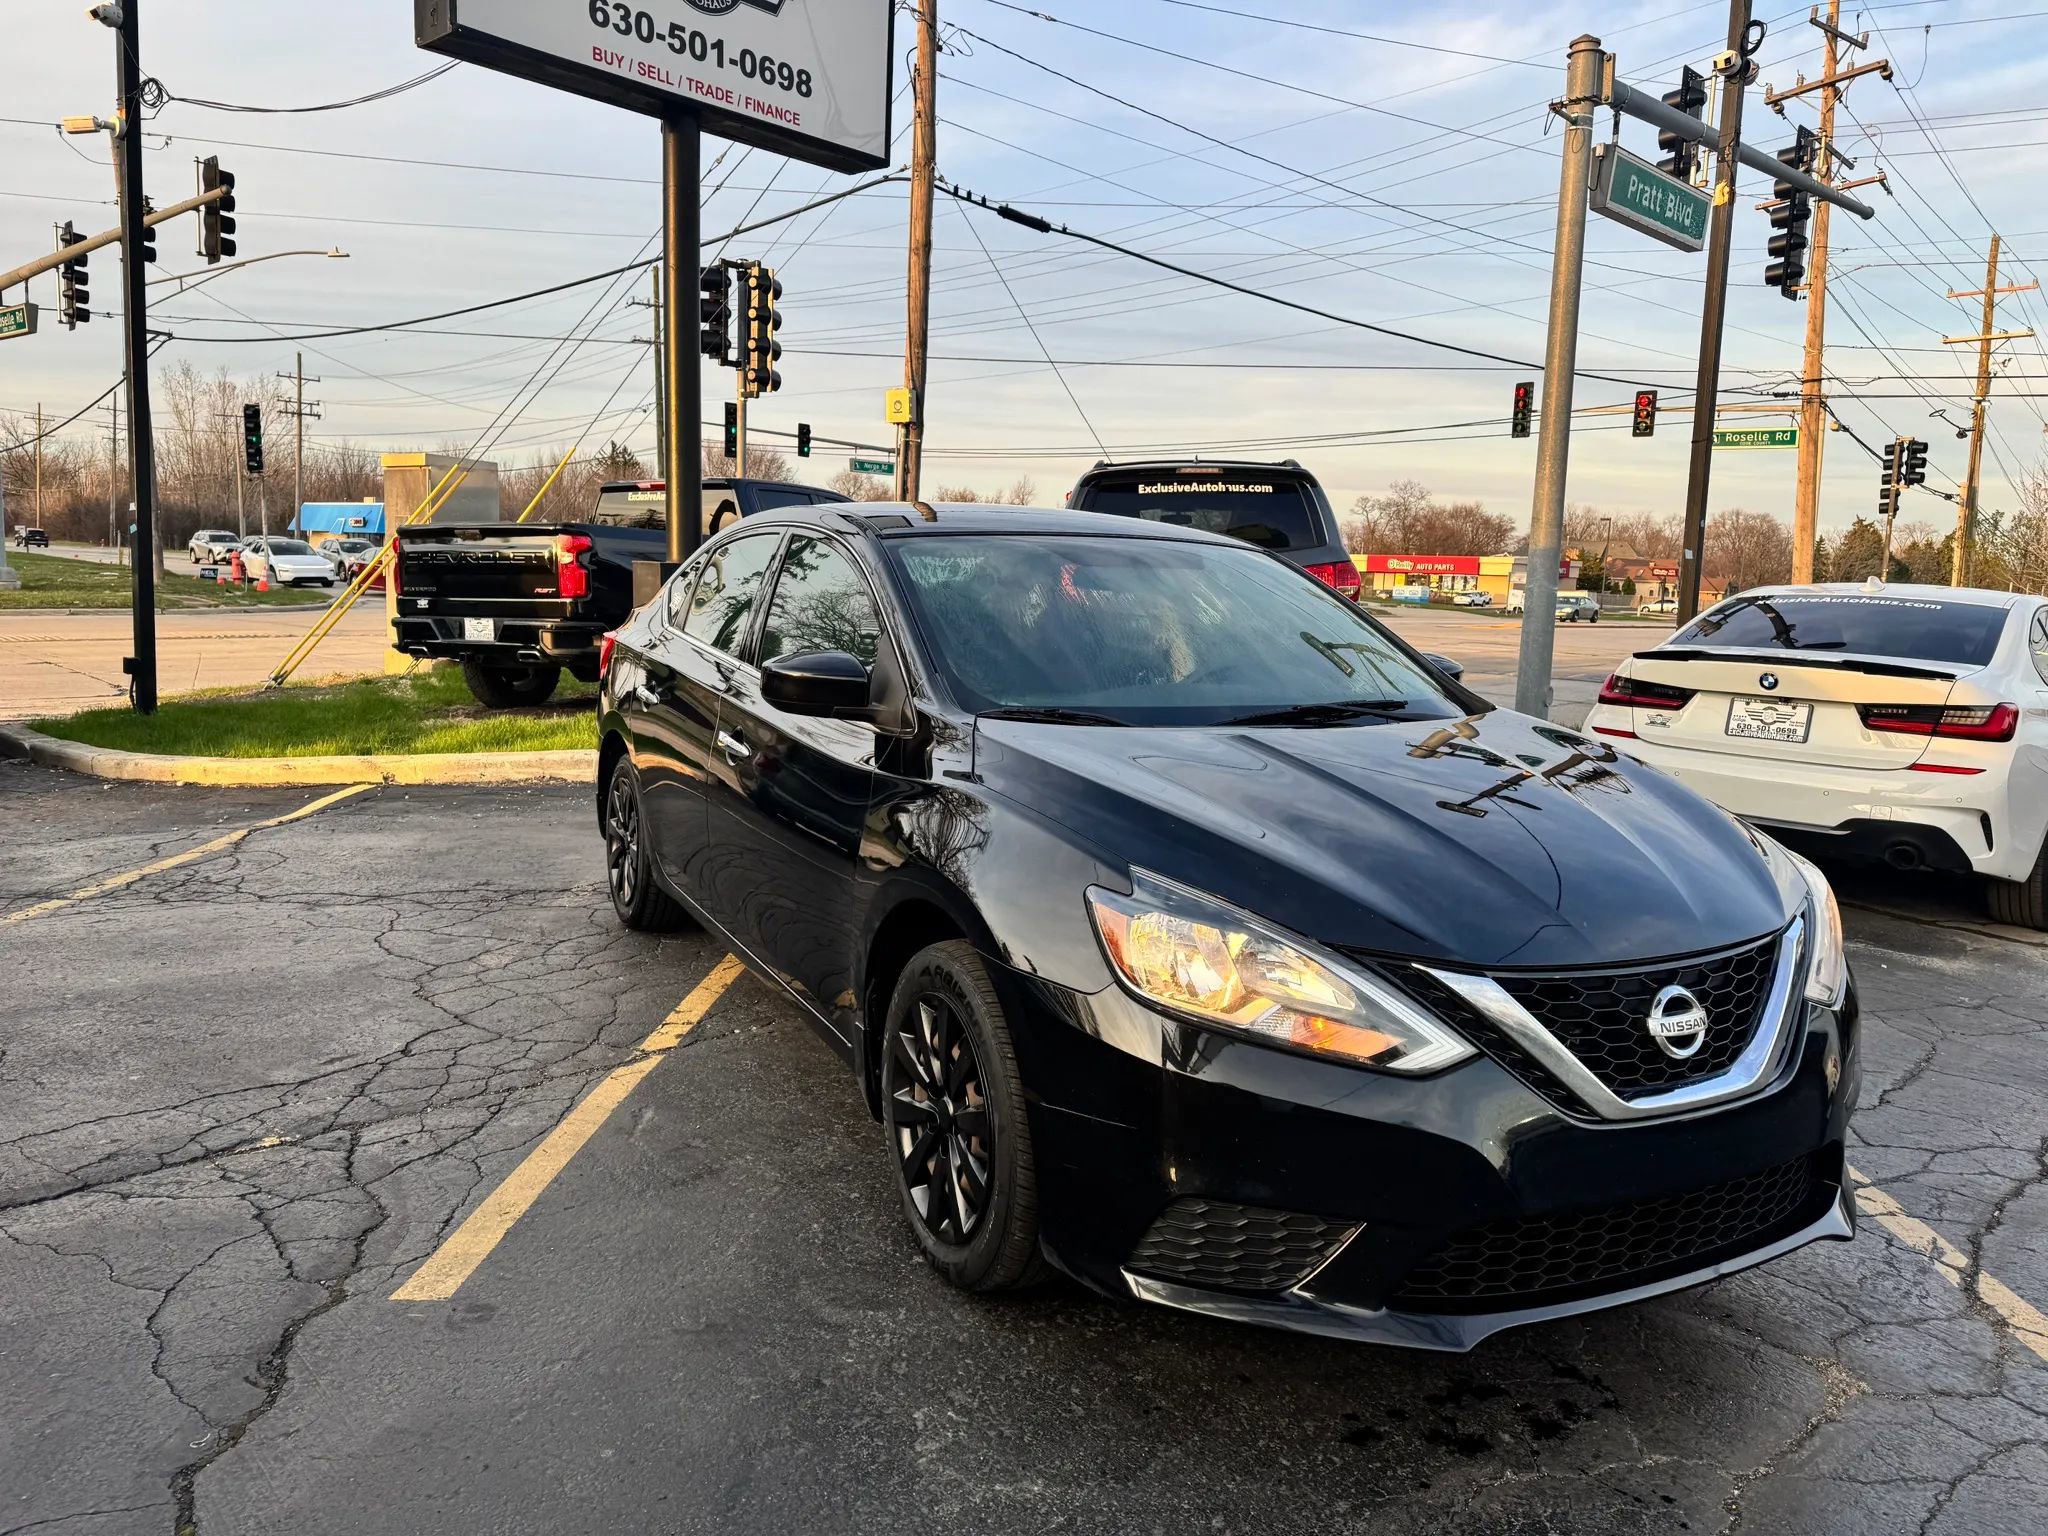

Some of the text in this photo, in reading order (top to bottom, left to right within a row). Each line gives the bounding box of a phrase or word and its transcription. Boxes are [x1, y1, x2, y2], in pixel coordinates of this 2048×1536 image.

[588, 0, 813, 98] 630-501-0698
[592, 46, 625, 69] BUY
[637, 61, 674, 86] SELL
[686, 77, 734, 105] TRADE
[745, 96, 801, 126] FINANCE
[1627, 174, 1694, 227] Pratt Blvd
[1725, 431, 1791, 442] Roselle Rd
[406, 552, 544, 564] CHEVROLET
[1416, 563, 1433, 571] AUTO
[1433, 563, 1455, 571] PARTS
[1755, 596, 1942, 610] xclusiveAutohaus.com
[1736, 722, 1798, 735] 630-501-0698
[1660, 1015, 1706, 1034] NISSAN
